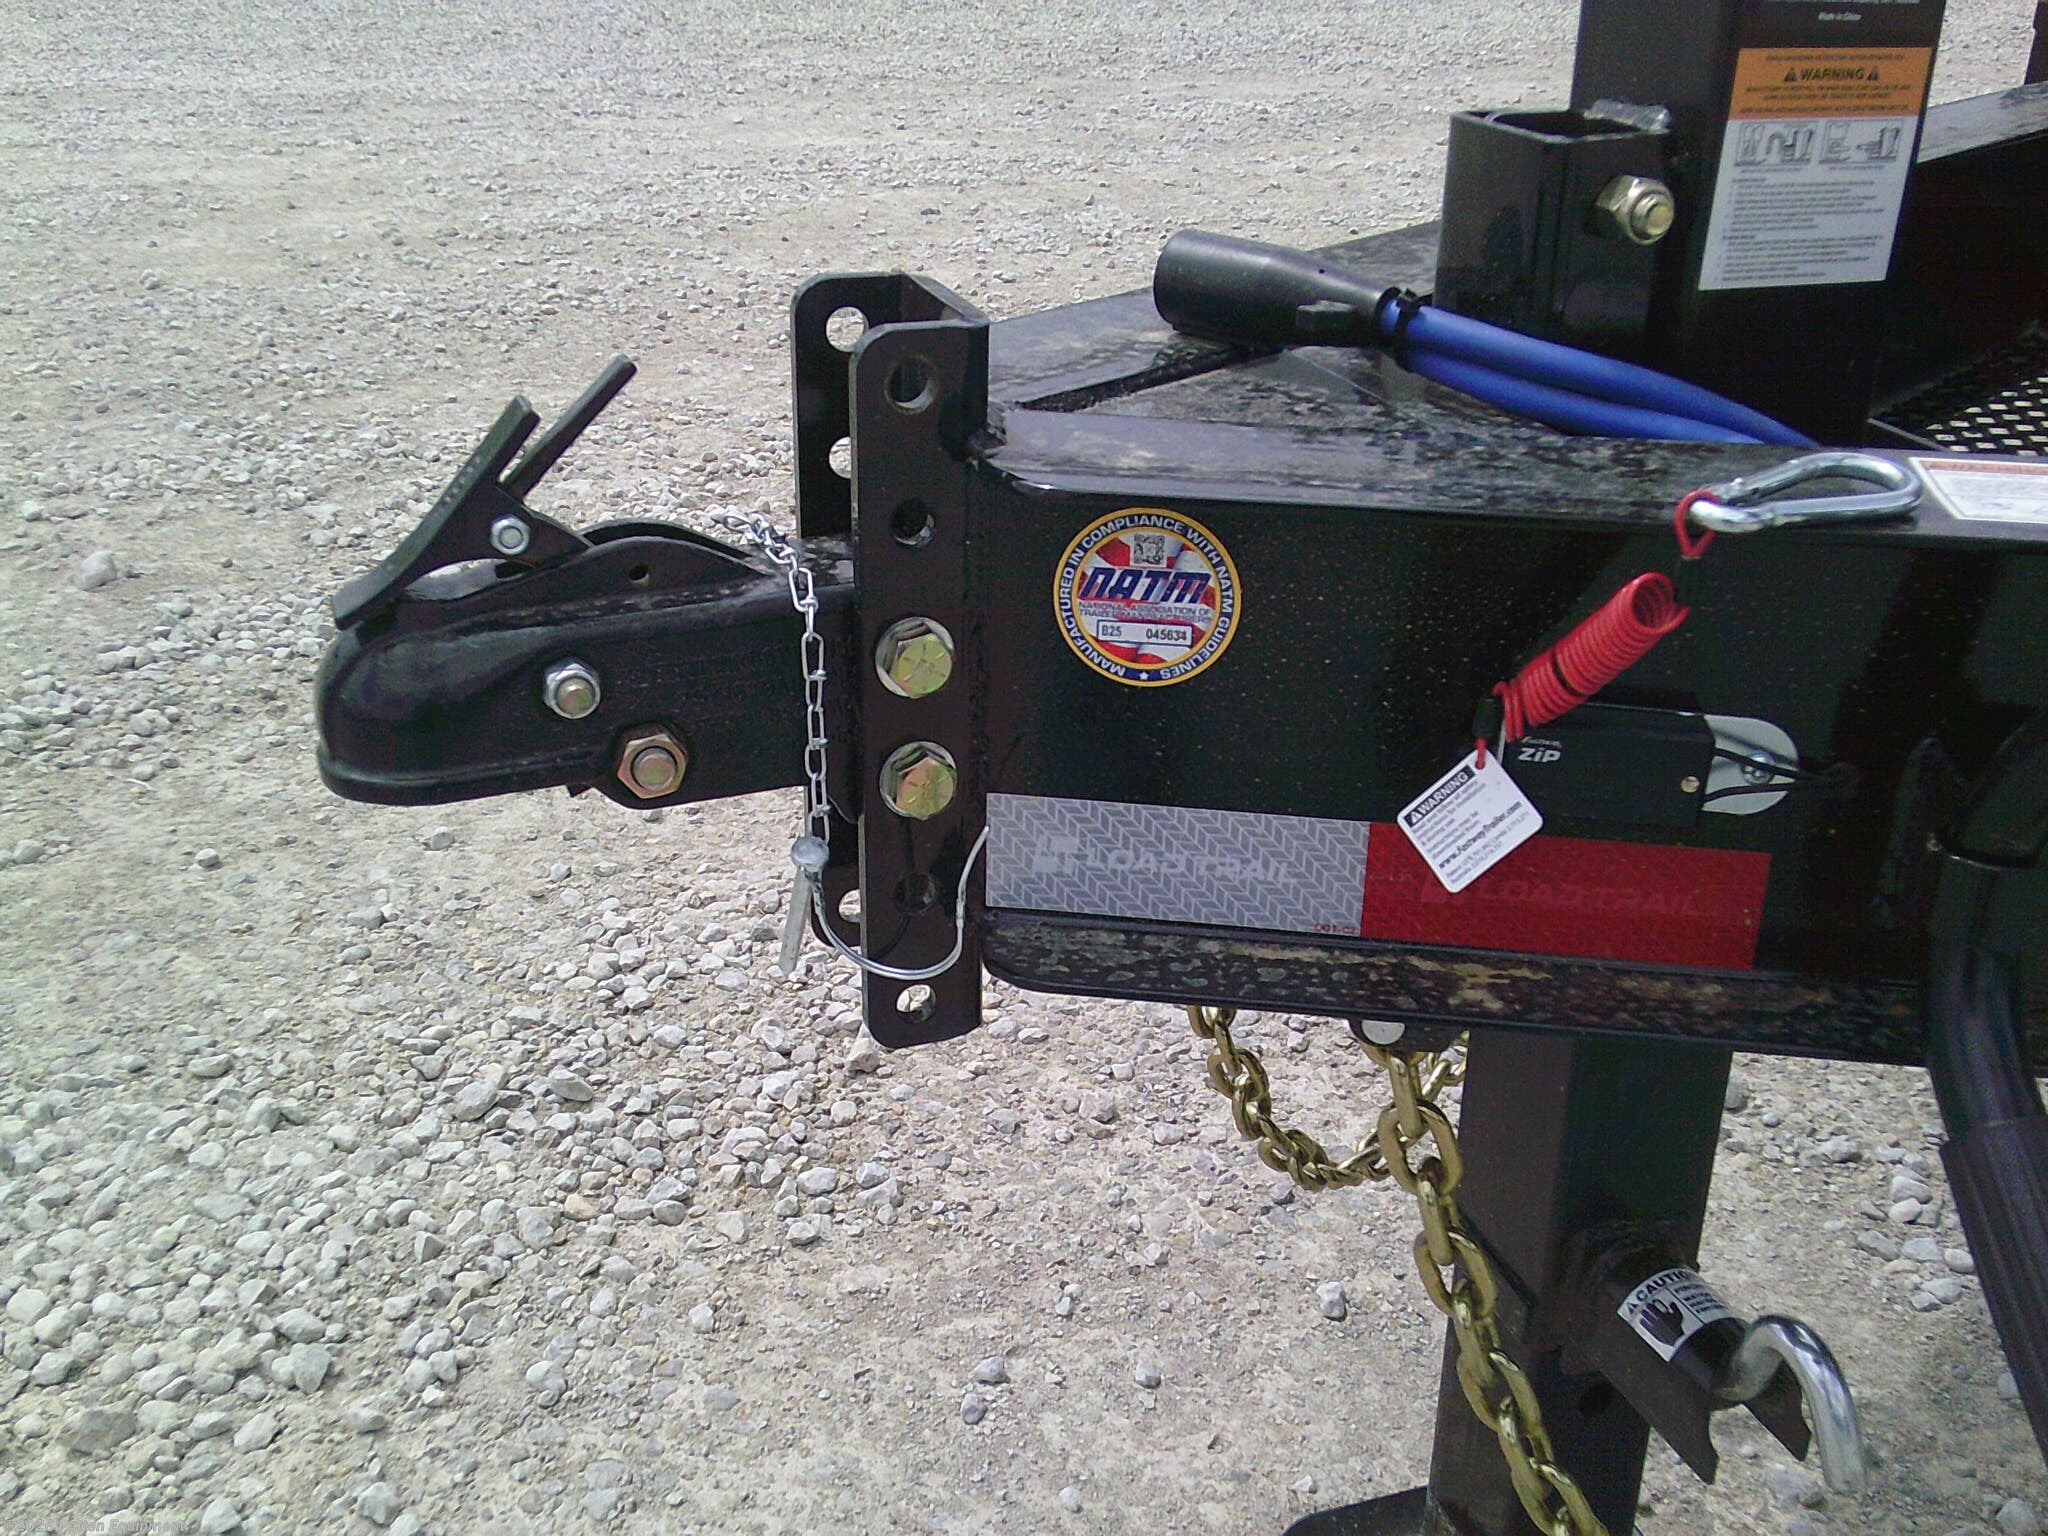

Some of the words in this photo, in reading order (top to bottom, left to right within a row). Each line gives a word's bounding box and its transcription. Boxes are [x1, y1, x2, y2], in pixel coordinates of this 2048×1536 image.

[1801, 67, 1866, 81] WARNING
[1083, 515, 1185, 549] COMPLIANCE
[1187, 528, 1222, 565] WITH
[1069, 549, 1086, 567] IN
[1216, 565, 1234, 614] NATM
[1059, 568, 1126, 677] MANUFACTURED
[1131, 603, 1197, 616] ASSOCIATION
[1198, 607, 1211, 616] OF
[1145, 628, 1187, 641] 045634
[1160, 615, 1233, 680] GUIDELINES
[1417, 770, 1469, 816] WARNING
[1636, 1270, 1694, 1303] CAUTIO
